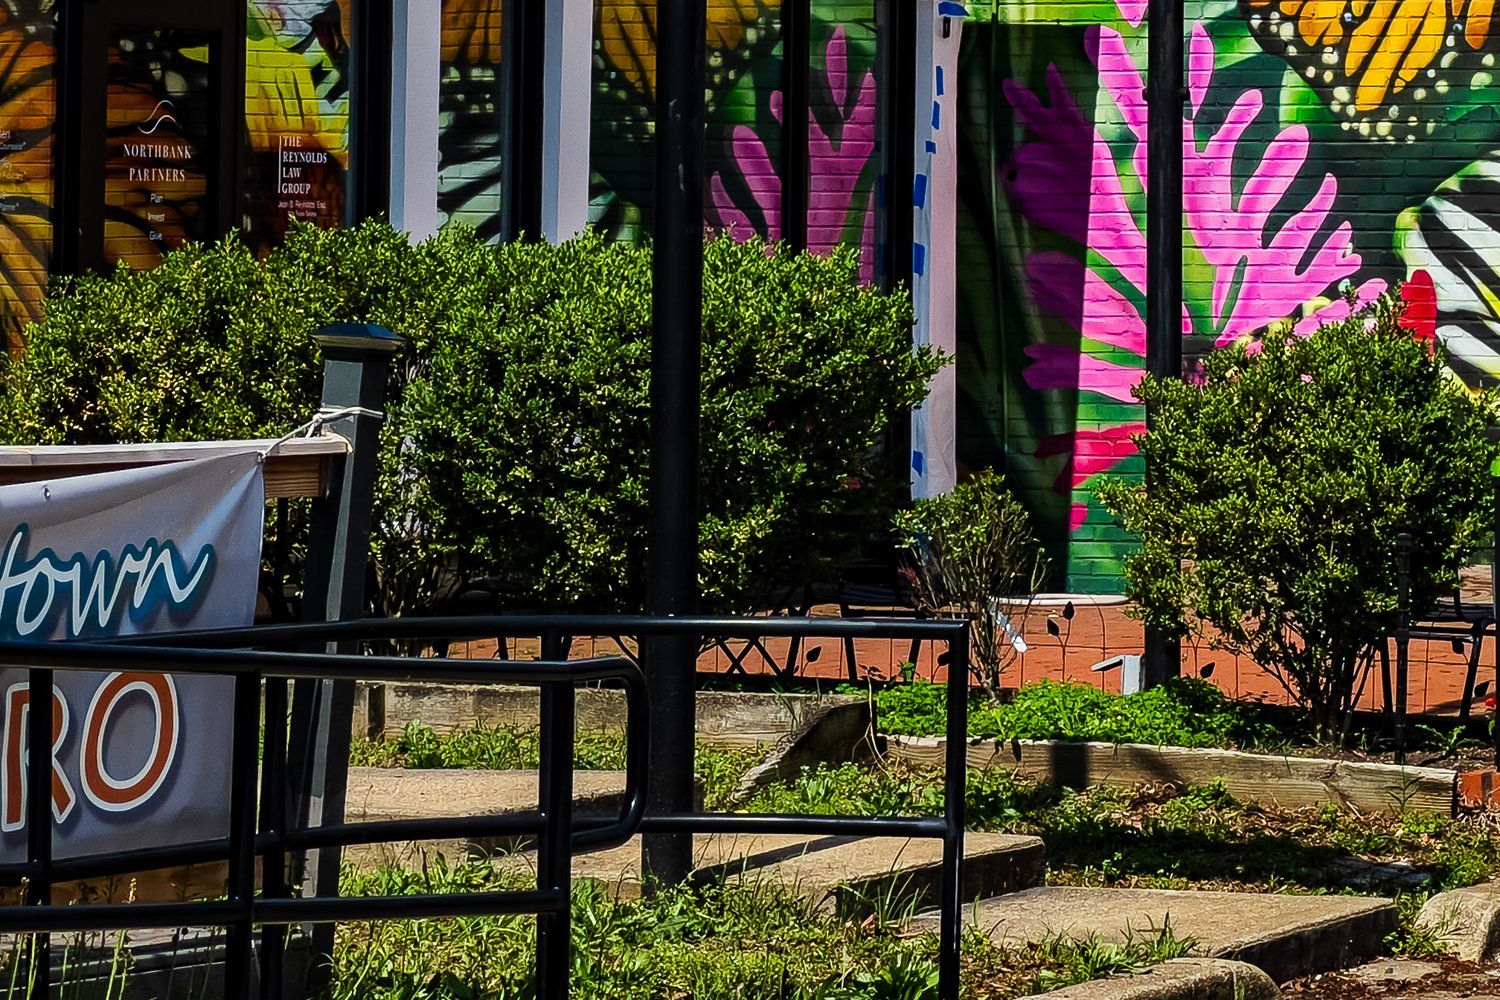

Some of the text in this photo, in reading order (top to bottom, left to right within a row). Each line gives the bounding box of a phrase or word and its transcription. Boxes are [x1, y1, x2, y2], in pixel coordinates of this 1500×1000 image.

[282, 135, 302, 147] THE
[123, 144, 192, 159] NORTHBANK
[282, 151, 328, 164] REYNOLDS
[129, 167, 186, 182] PARTNERS
[282, 167, 302, 178] LAW
[281, 183, 311, 195] GROUP
[150, 193, 163, 203] Plan
[147, 212, 165, 222] Invest
